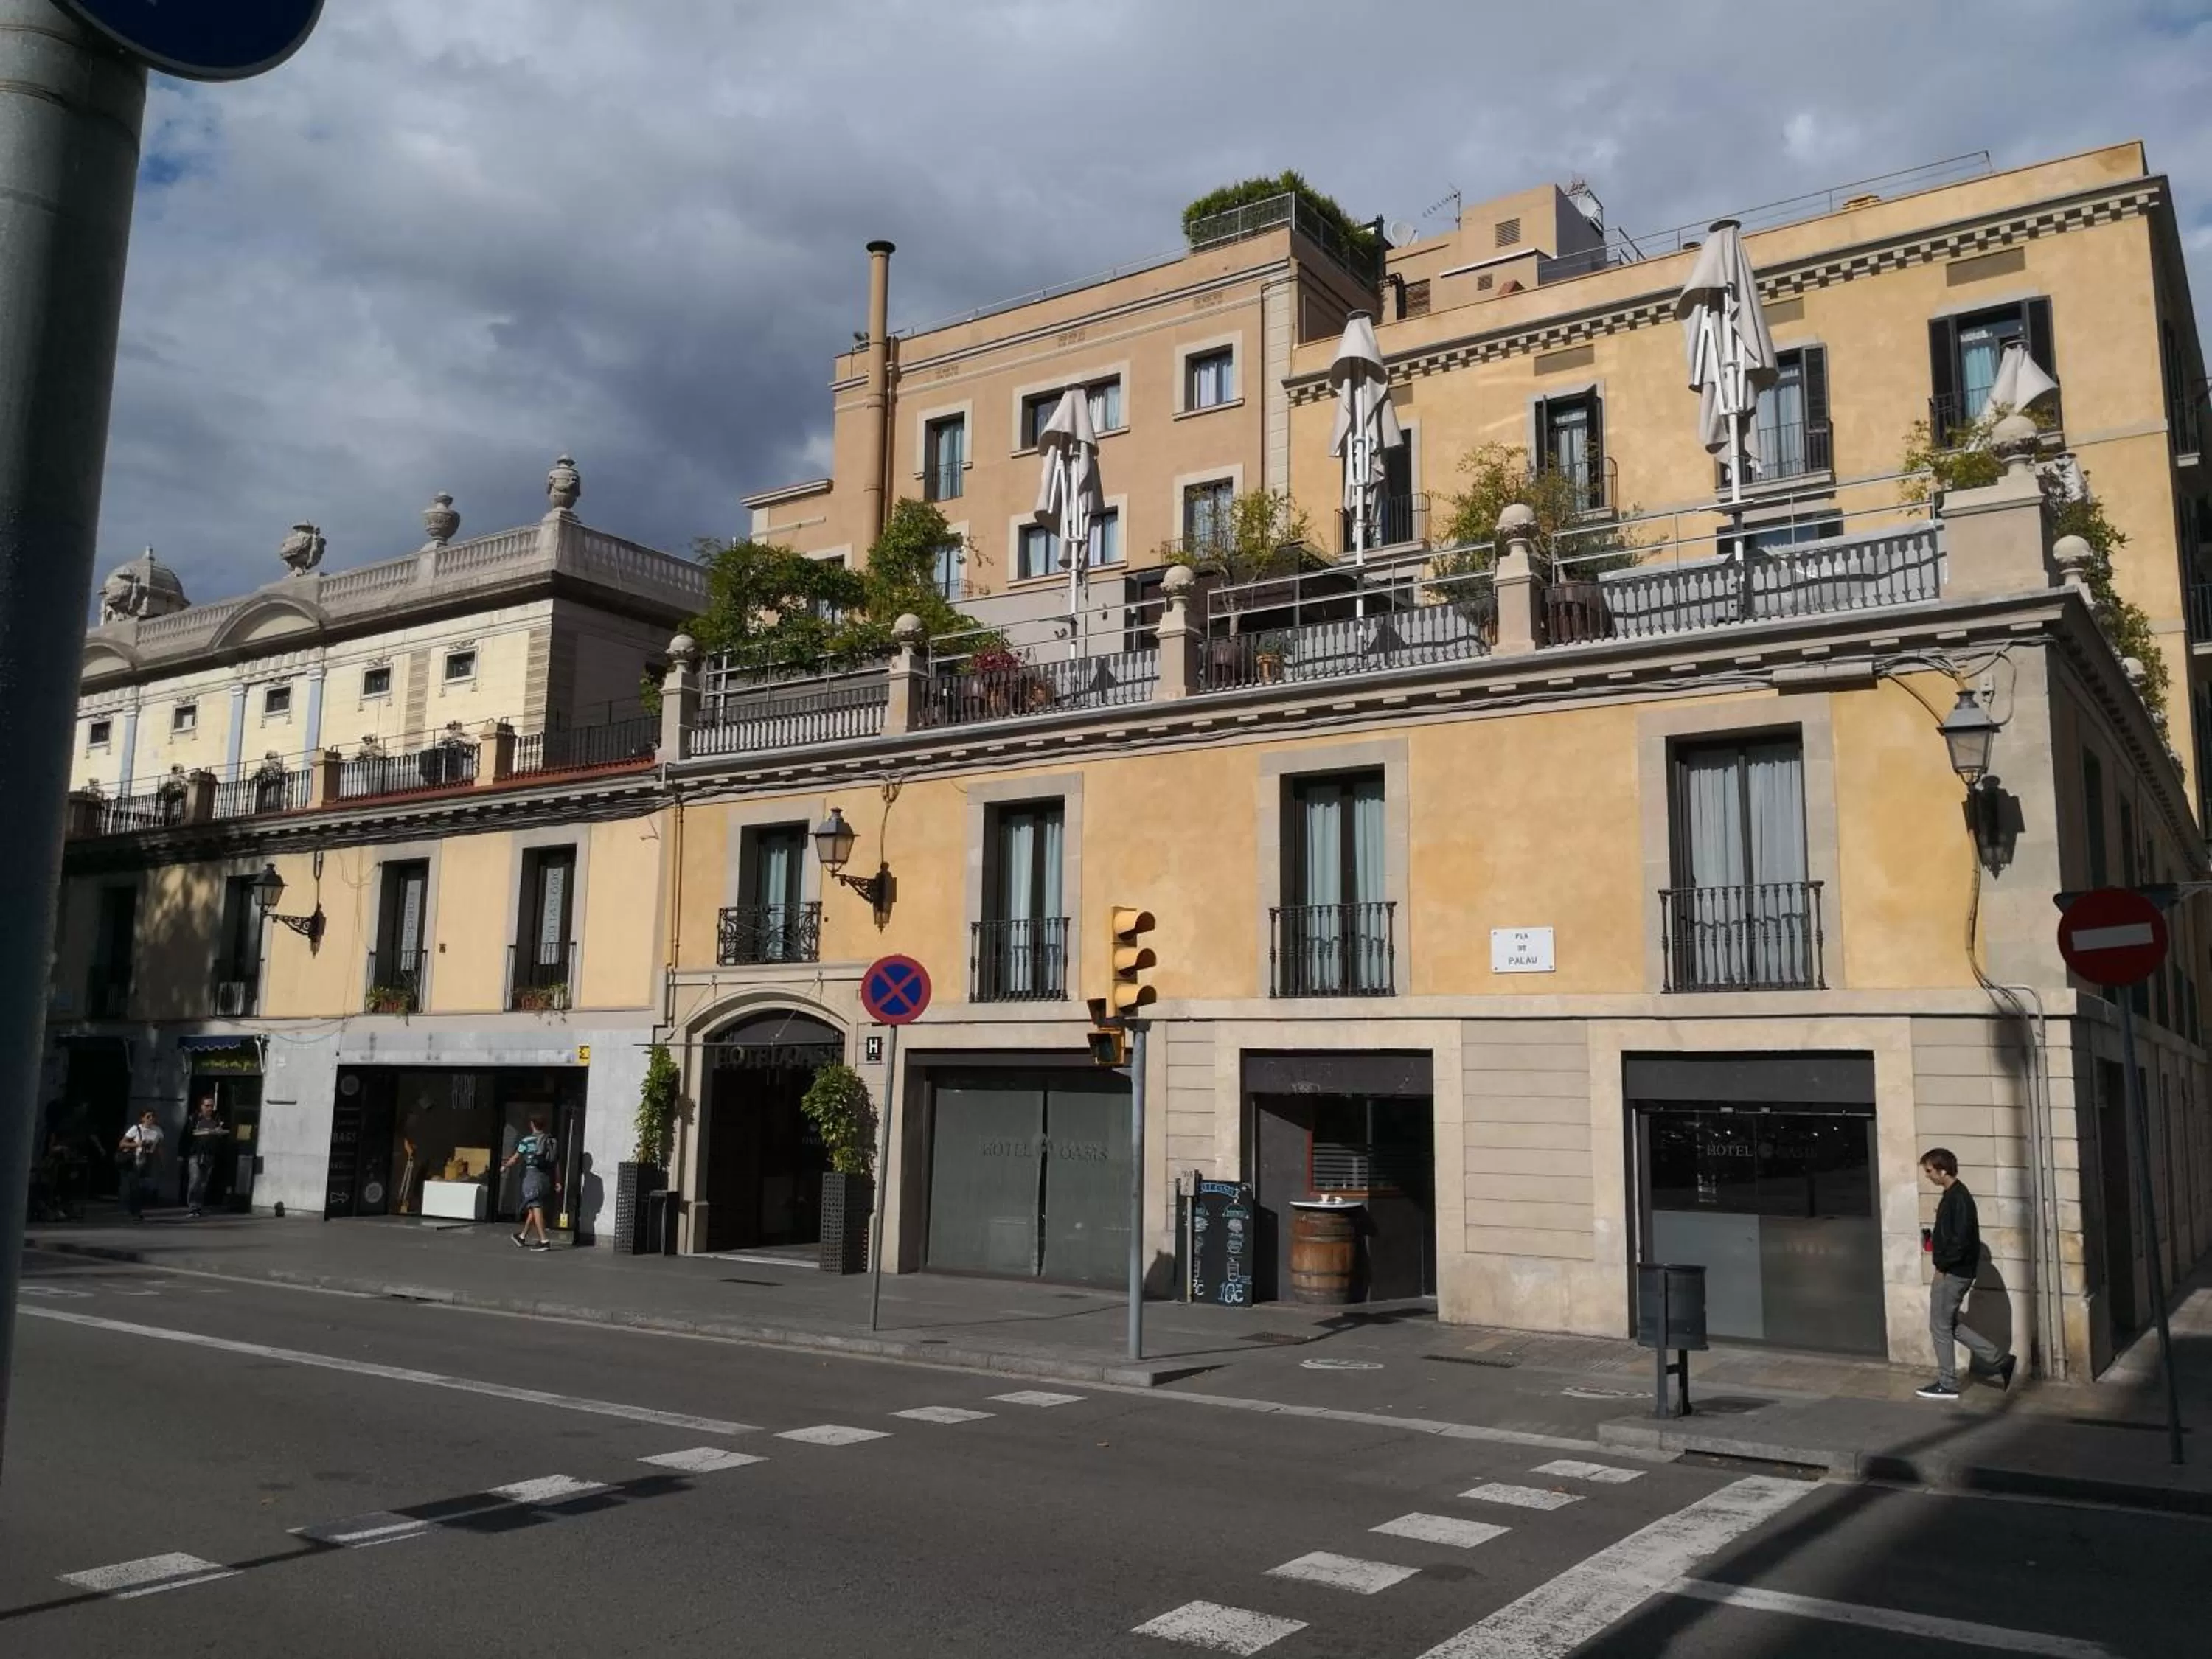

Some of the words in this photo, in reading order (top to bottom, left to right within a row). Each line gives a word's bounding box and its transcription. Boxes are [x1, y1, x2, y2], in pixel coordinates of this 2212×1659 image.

[1509, 956, 1537, 965] PALAU
[869, 1038, 878, 1054] H
[1707, 1144, 1753, 1157] HOTEL
